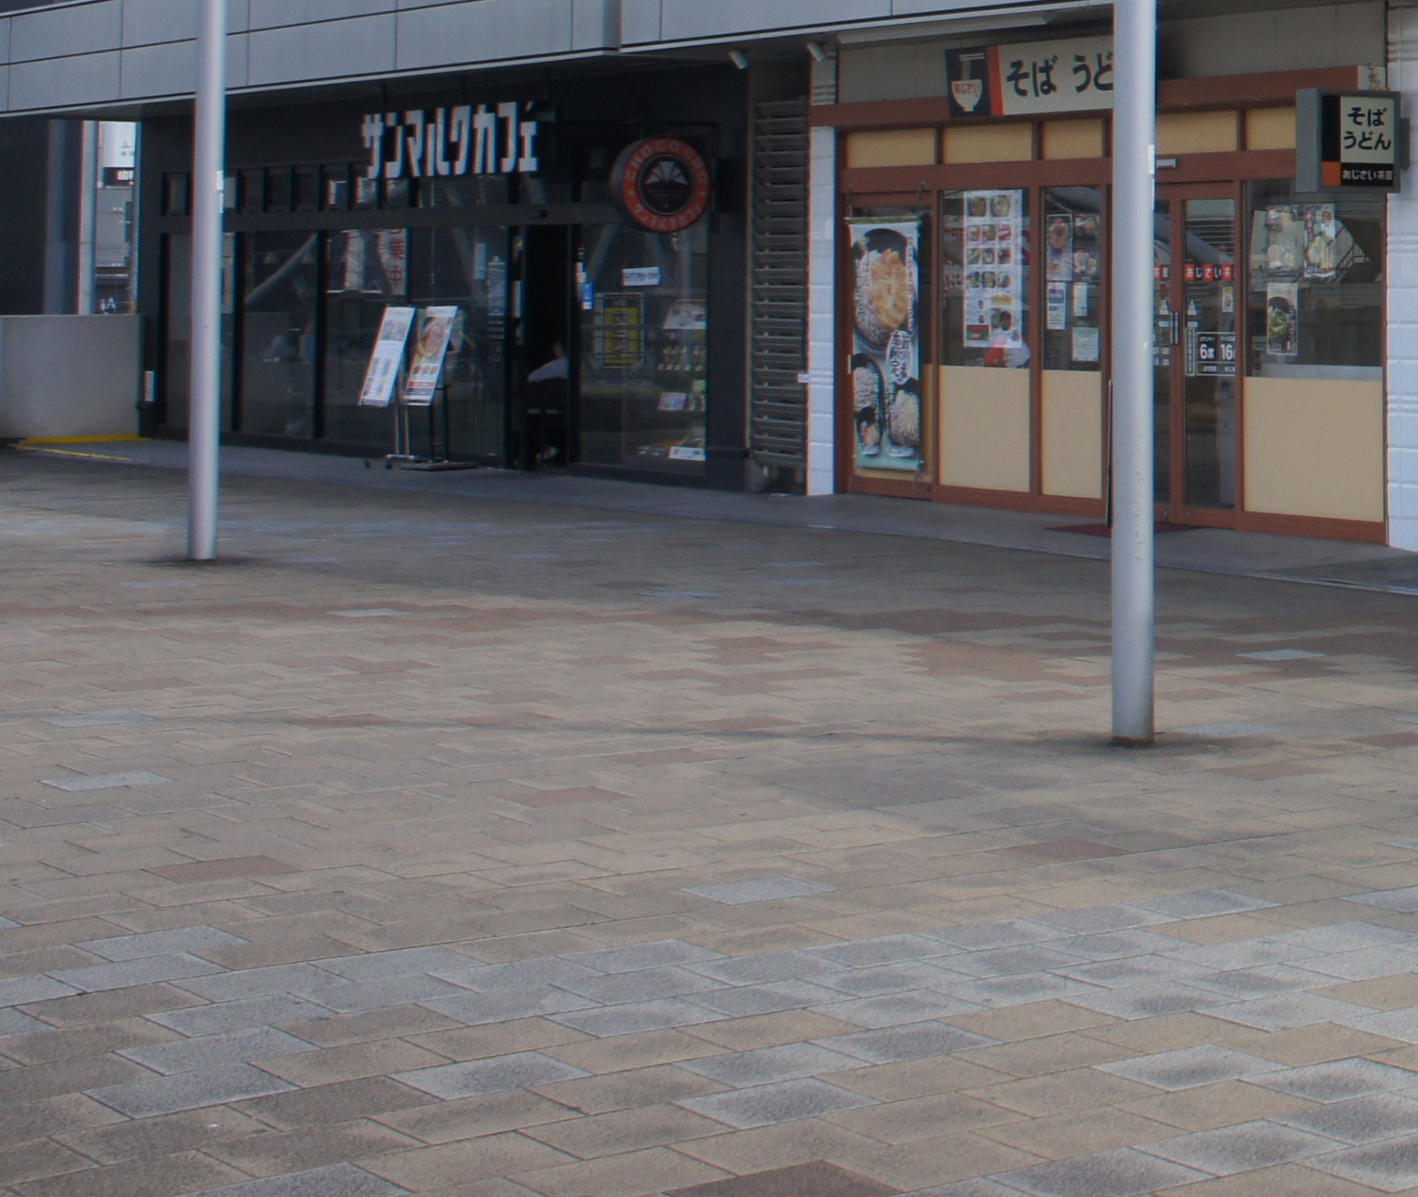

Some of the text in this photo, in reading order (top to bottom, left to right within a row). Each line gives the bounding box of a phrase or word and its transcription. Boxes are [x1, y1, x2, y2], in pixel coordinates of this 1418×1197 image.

[1005, 51, 1115, 98] そば うど
[953, 82, 981, 97] あじさい
[1347, 106, 1388, 127] そば
[361, 100, 541, 180] サンマルクカフェ
[1343, 130, 1392, 151] うどん
[625, 139, 709, 183] CHOCOCRO
[1341, 168, 1393, 182] あじさい茶屋
[1186, 265, 1235, 279] あじさい茶
[1220, 343, 1236, 361] 16
